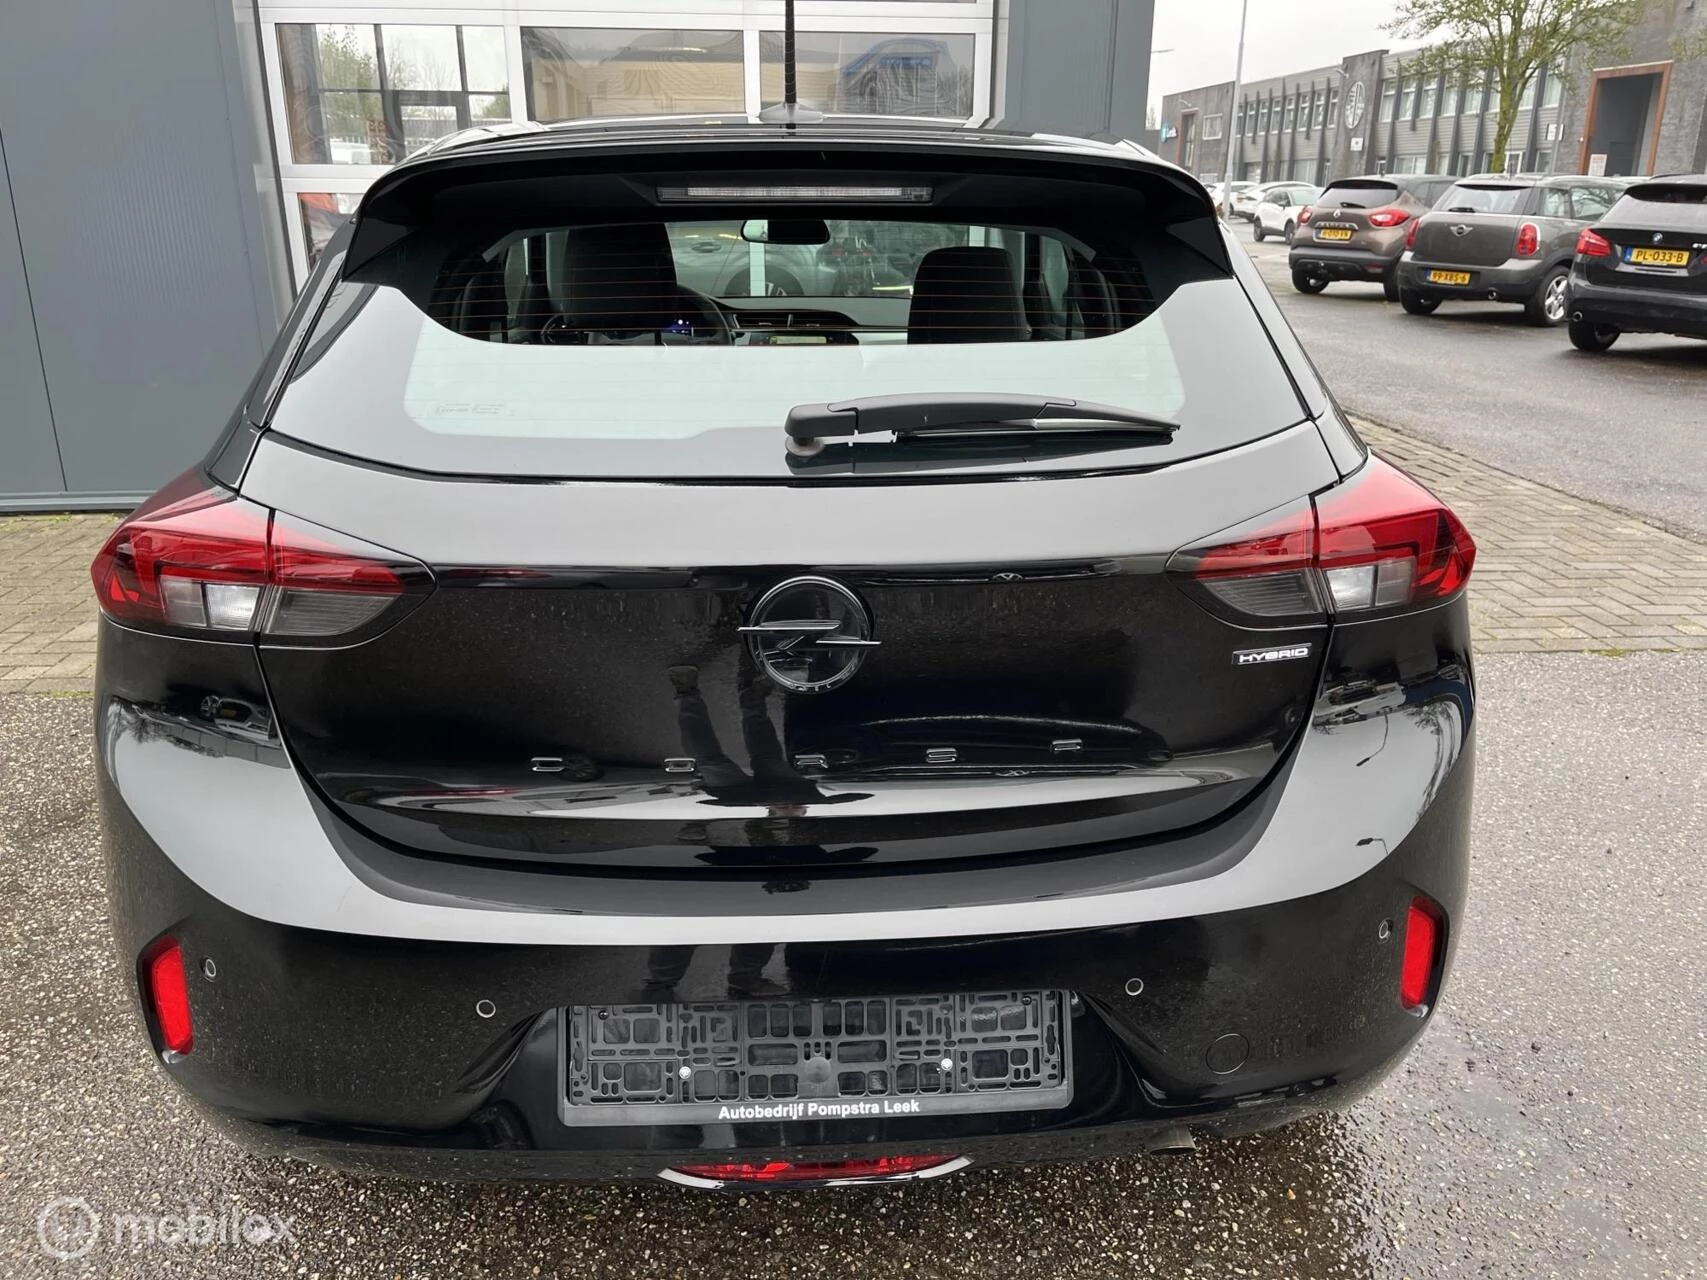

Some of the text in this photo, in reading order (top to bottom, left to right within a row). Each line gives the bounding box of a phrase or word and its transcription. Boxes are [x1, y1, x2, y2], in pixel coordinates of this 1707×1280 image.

[1635, 250, 1685, 263] PL-033-B
[1239, 647, 1309, 663] HYBRID
[718, 1099, 920, 1120] Autobedrijf Pompstra Leek
